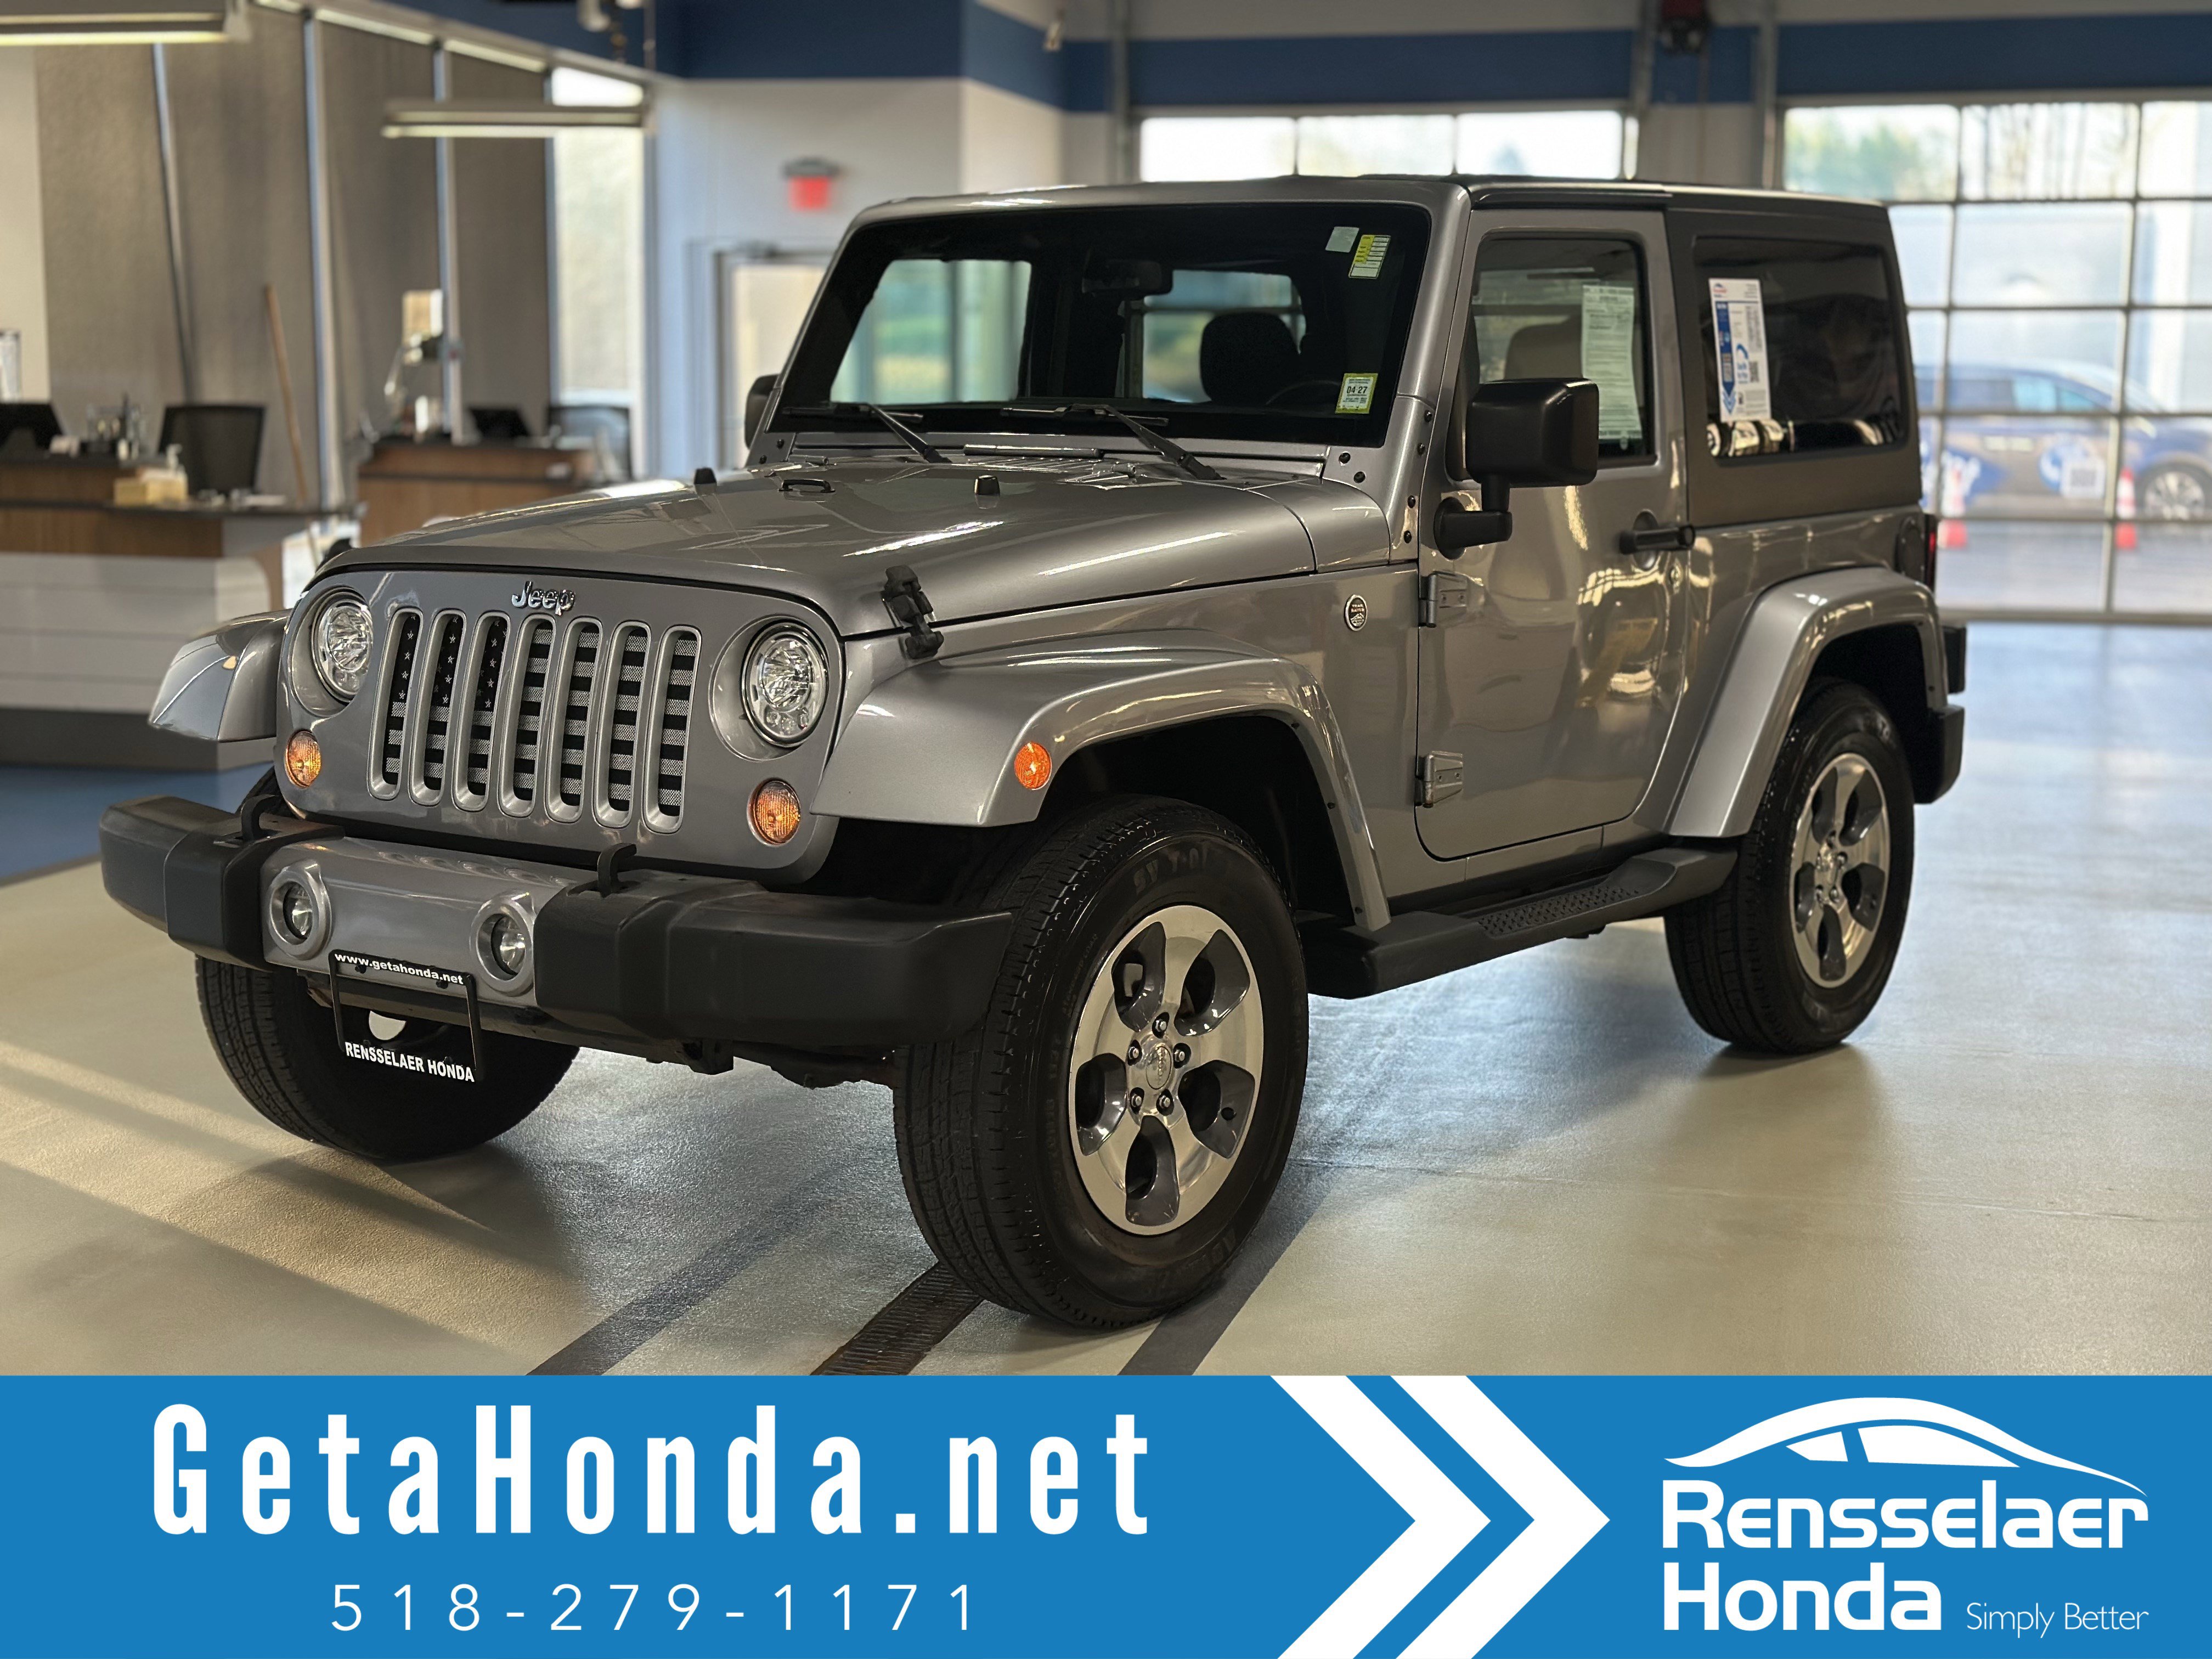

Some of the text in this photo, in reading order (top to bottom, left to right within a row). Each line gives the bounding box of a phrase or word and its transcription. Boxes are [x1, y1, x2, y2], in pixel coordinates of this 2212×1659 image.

[511, 580, 575, 616] Jeep
[334, 953, 464, 985] www.getahonda.net
[345, 1042, 475, 1082] RENSSELAER HONDA
